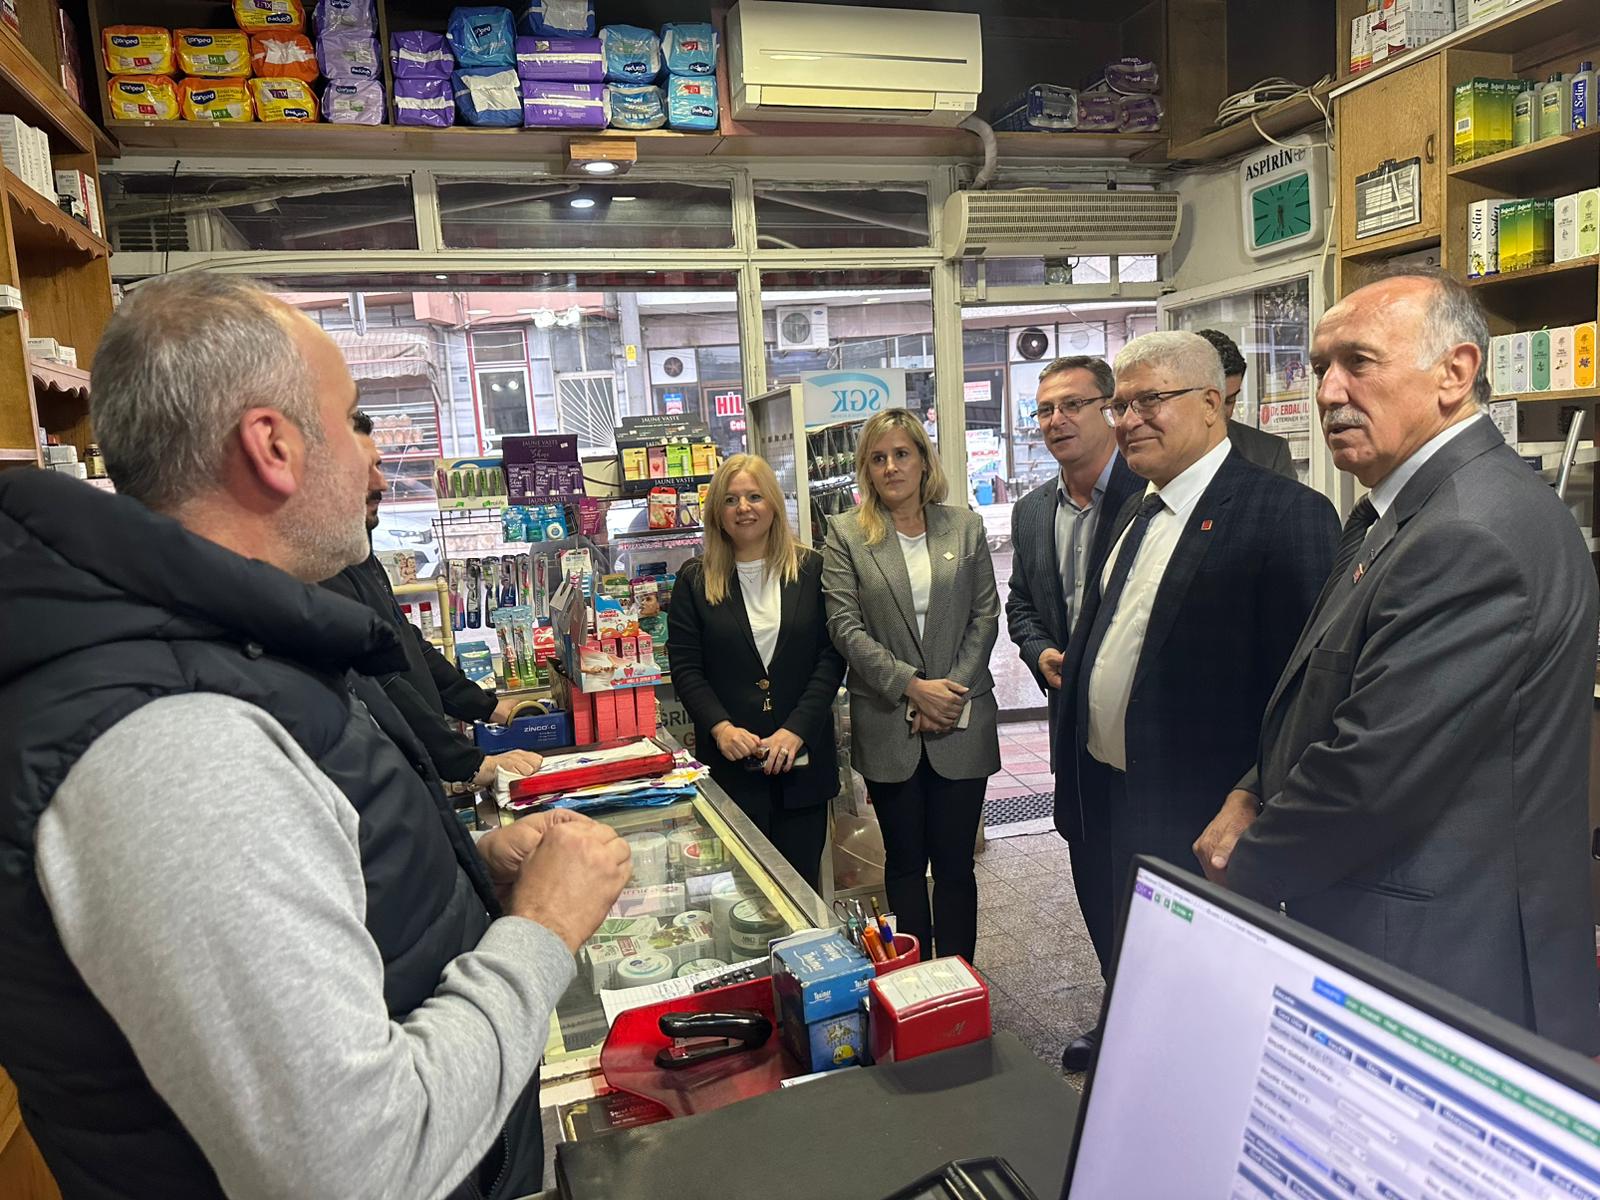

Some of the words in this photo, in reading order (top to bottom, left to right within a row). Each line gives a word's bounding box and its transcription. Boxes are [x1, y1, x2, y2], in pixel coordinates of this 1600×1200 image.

[1574, 82, 1584, 108] Selin
[1246, 148, 1293, 181] ASPİRİN
[1472, 208, 1482, 241] Selin
